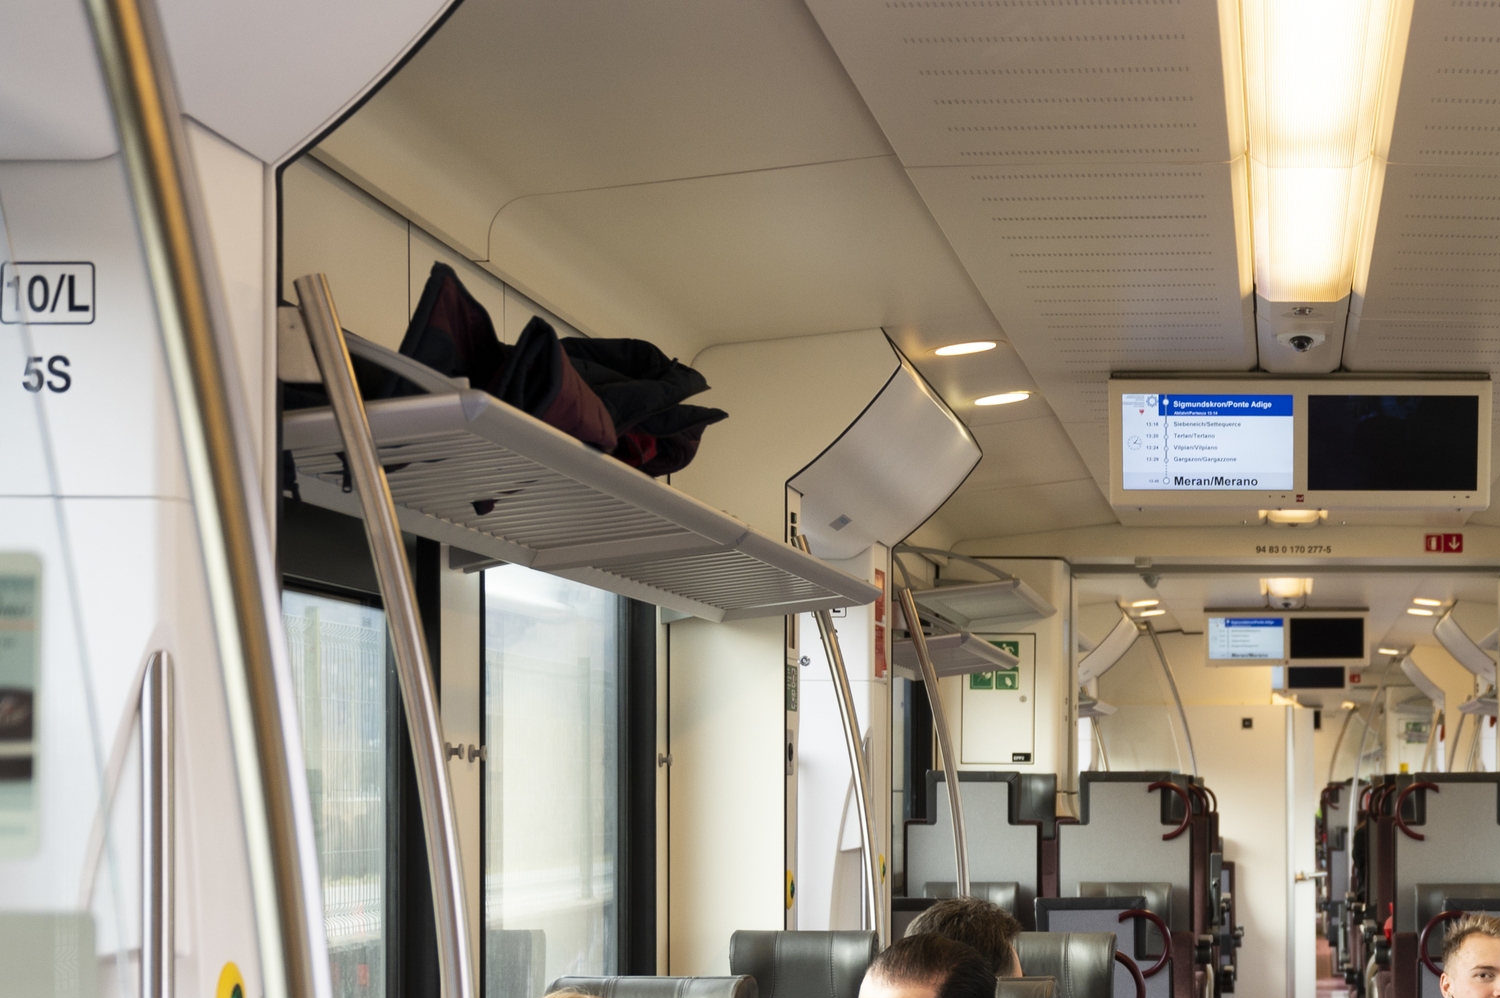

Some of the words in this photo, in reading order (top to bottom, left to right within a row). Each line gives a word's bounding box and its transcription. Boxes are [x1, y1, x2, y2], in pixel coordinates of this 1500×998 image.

[6, 273, 90, 313] 10/L
[22, 354, 72, 393] 5S
[1173, 400, 1249, 409] Sigmundskron/Ponte
[1251, 400, 1272, 409] Adige
[1174, 476, 1258, 486] Meran/Merano
[1255, 545, 1266, 554] 94
[1268, 545, 1279, 554] 83
[1281, 545, 1288, 554] 0
[1290, 545, 1306, 554] 170
[1307, 545, 1332, 554] 277-5
